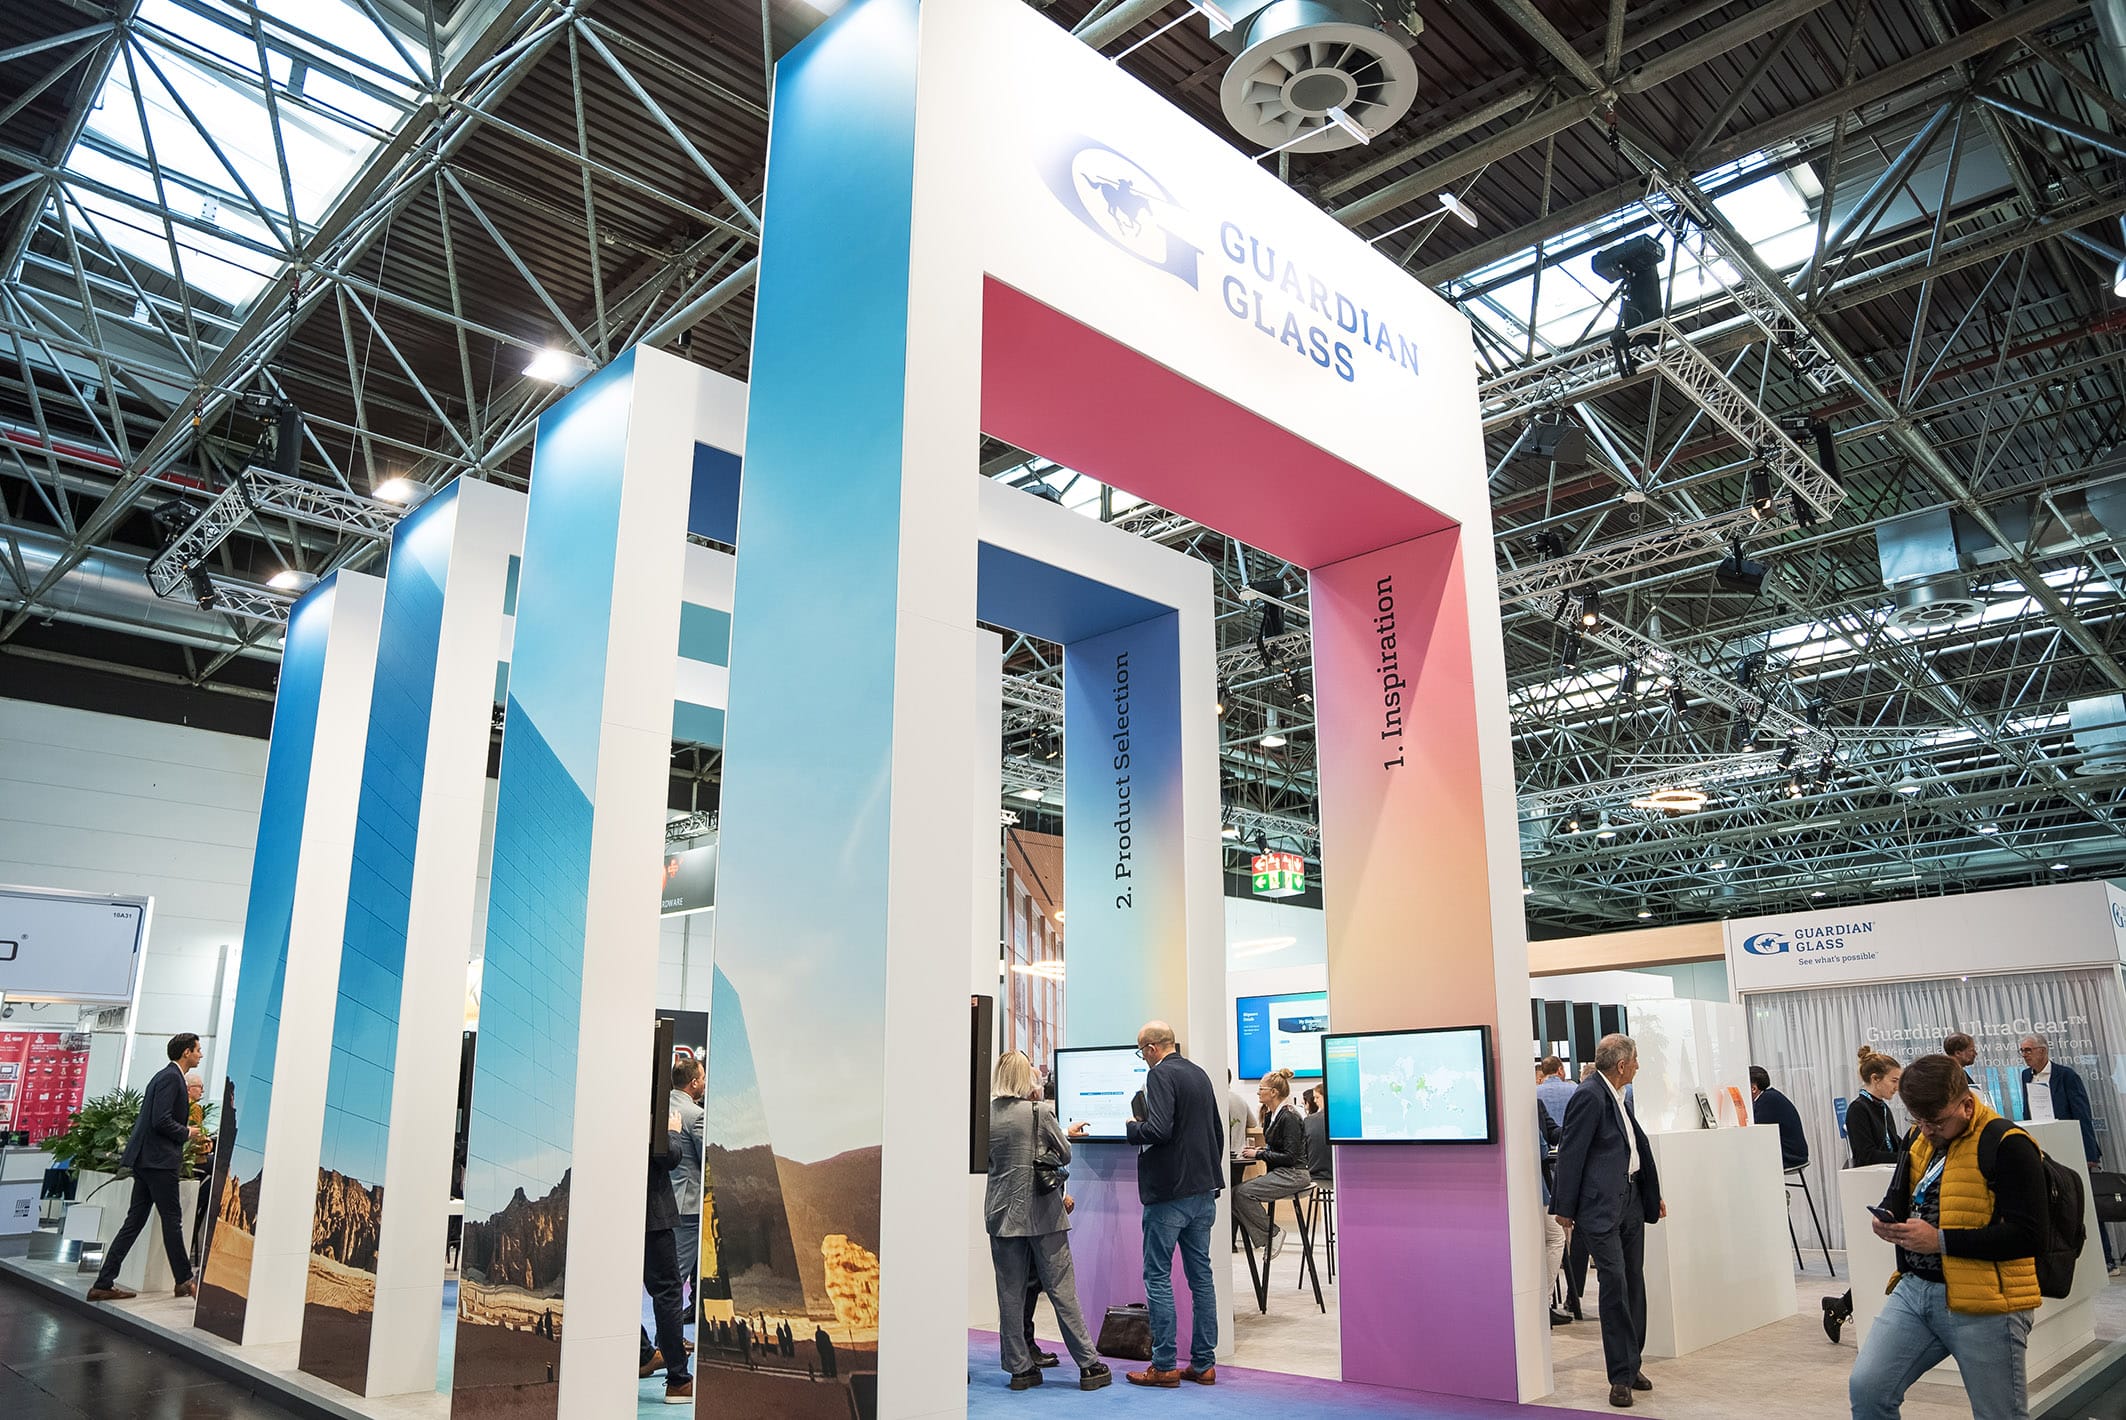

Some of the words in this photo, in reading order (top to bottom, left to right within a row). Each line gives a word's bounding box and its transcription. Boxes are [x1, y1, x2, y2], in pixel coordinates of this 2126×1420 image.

[1220, 220, 1420, 376] GUARDIAN
[1222, 275, 1355, 383] GLASS
[1373, 575, 1406, 740] Inspiration
[1112, 651, 1130, 770] Selection
[1384, 746, 1404, 770] 1.
[1114, 775, 1131, 881] Product
[1115, 886, 1132, 910] 2.
[1796, 938, 1844, 952] GLASS
[1798, 958, 1813, 966] See
[1814, 955, 1840, 965] what's
[1866, 1023, 1955, 1042] Guardian
[2058, 1037, 2093, 1049] from
